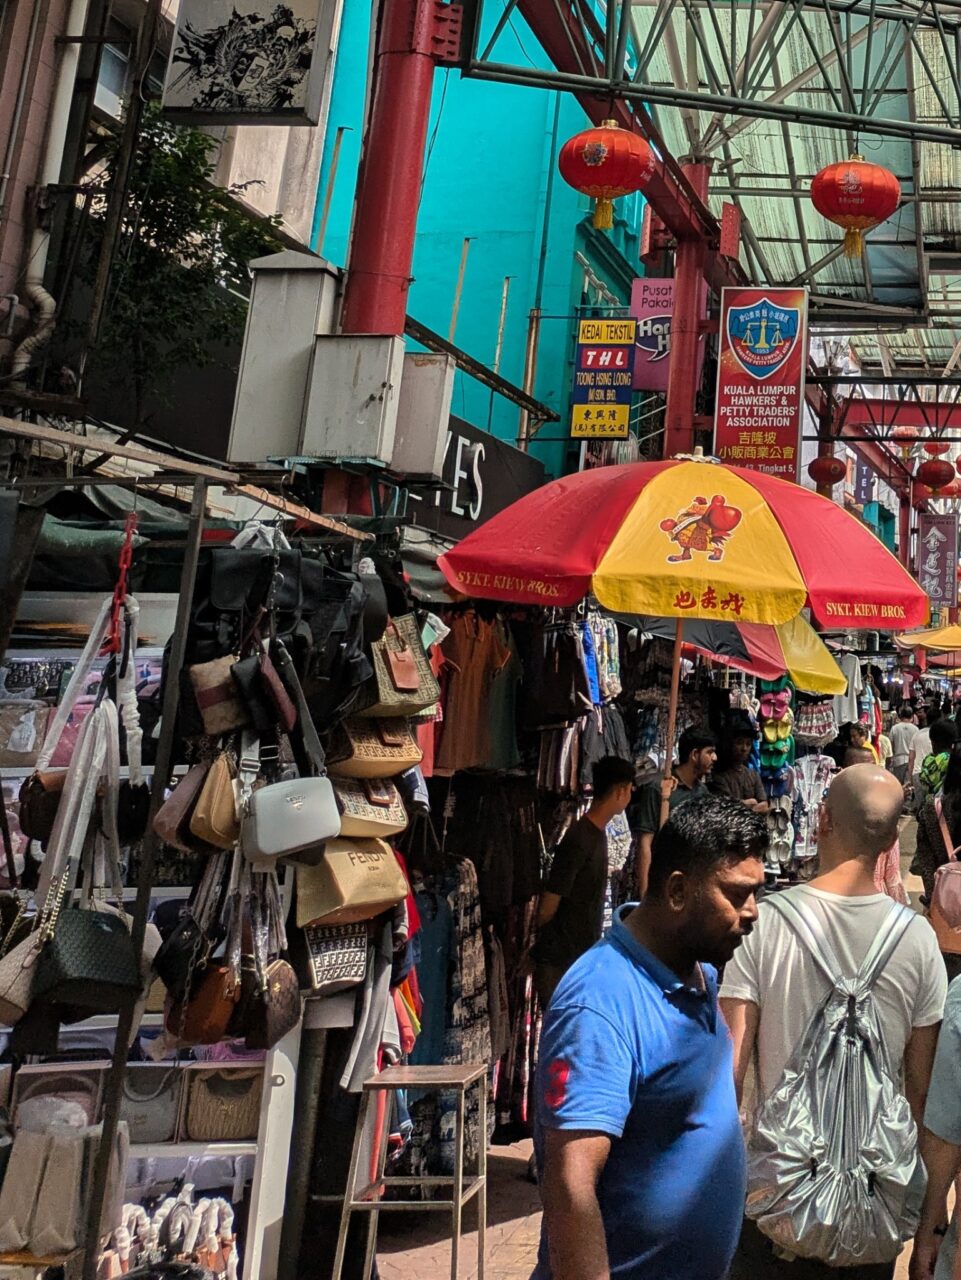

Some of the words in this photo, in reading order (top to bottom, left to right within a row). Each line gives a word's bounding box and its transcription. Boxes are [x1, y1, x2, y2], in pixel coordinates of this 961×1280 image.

[642, 285, 672, 296] Pusat
[641, 298, 674, 308] Pakai
[581, 324, 603, 340] KEDAI
[606, 325, 633, 340] TEKSTIL
[639, 320, 670, 337] Har
[576, 372, 595, 386] TOONG
[596, 372, 612, 386] HSING
[613, 372, 632, 386] LOONG
[723, 385, 755, 395] KUALA
[757, 385, 796, 395] LUMPUR
[731, 396, 779, 406] HAWKERS'
[781, 396, 788, 406] &
[720, 406, 751, 416] PETTY
[753, 406, 798, 416] TRADERS'
[726, 417, 790, 427] ASSOCIATION
[738, 431, 777, 445] 吉隆坡
[719, 445, 795, 459] 小販商業公會
[758, 464, 787, 474] Tingkat
[788, 464, 796, 474] 5,
[455, 570, 491, 587] SYKT.
[527, 579, 560, 597] BROS.
[826, 602, 852, 616] SYKT.
[854, 603, 880, 617] KIEW
[881, 604, 906, 619] BROS.
[348, 850, 387, 867] FENDI
[544, 1058, 570, 1108] 3
